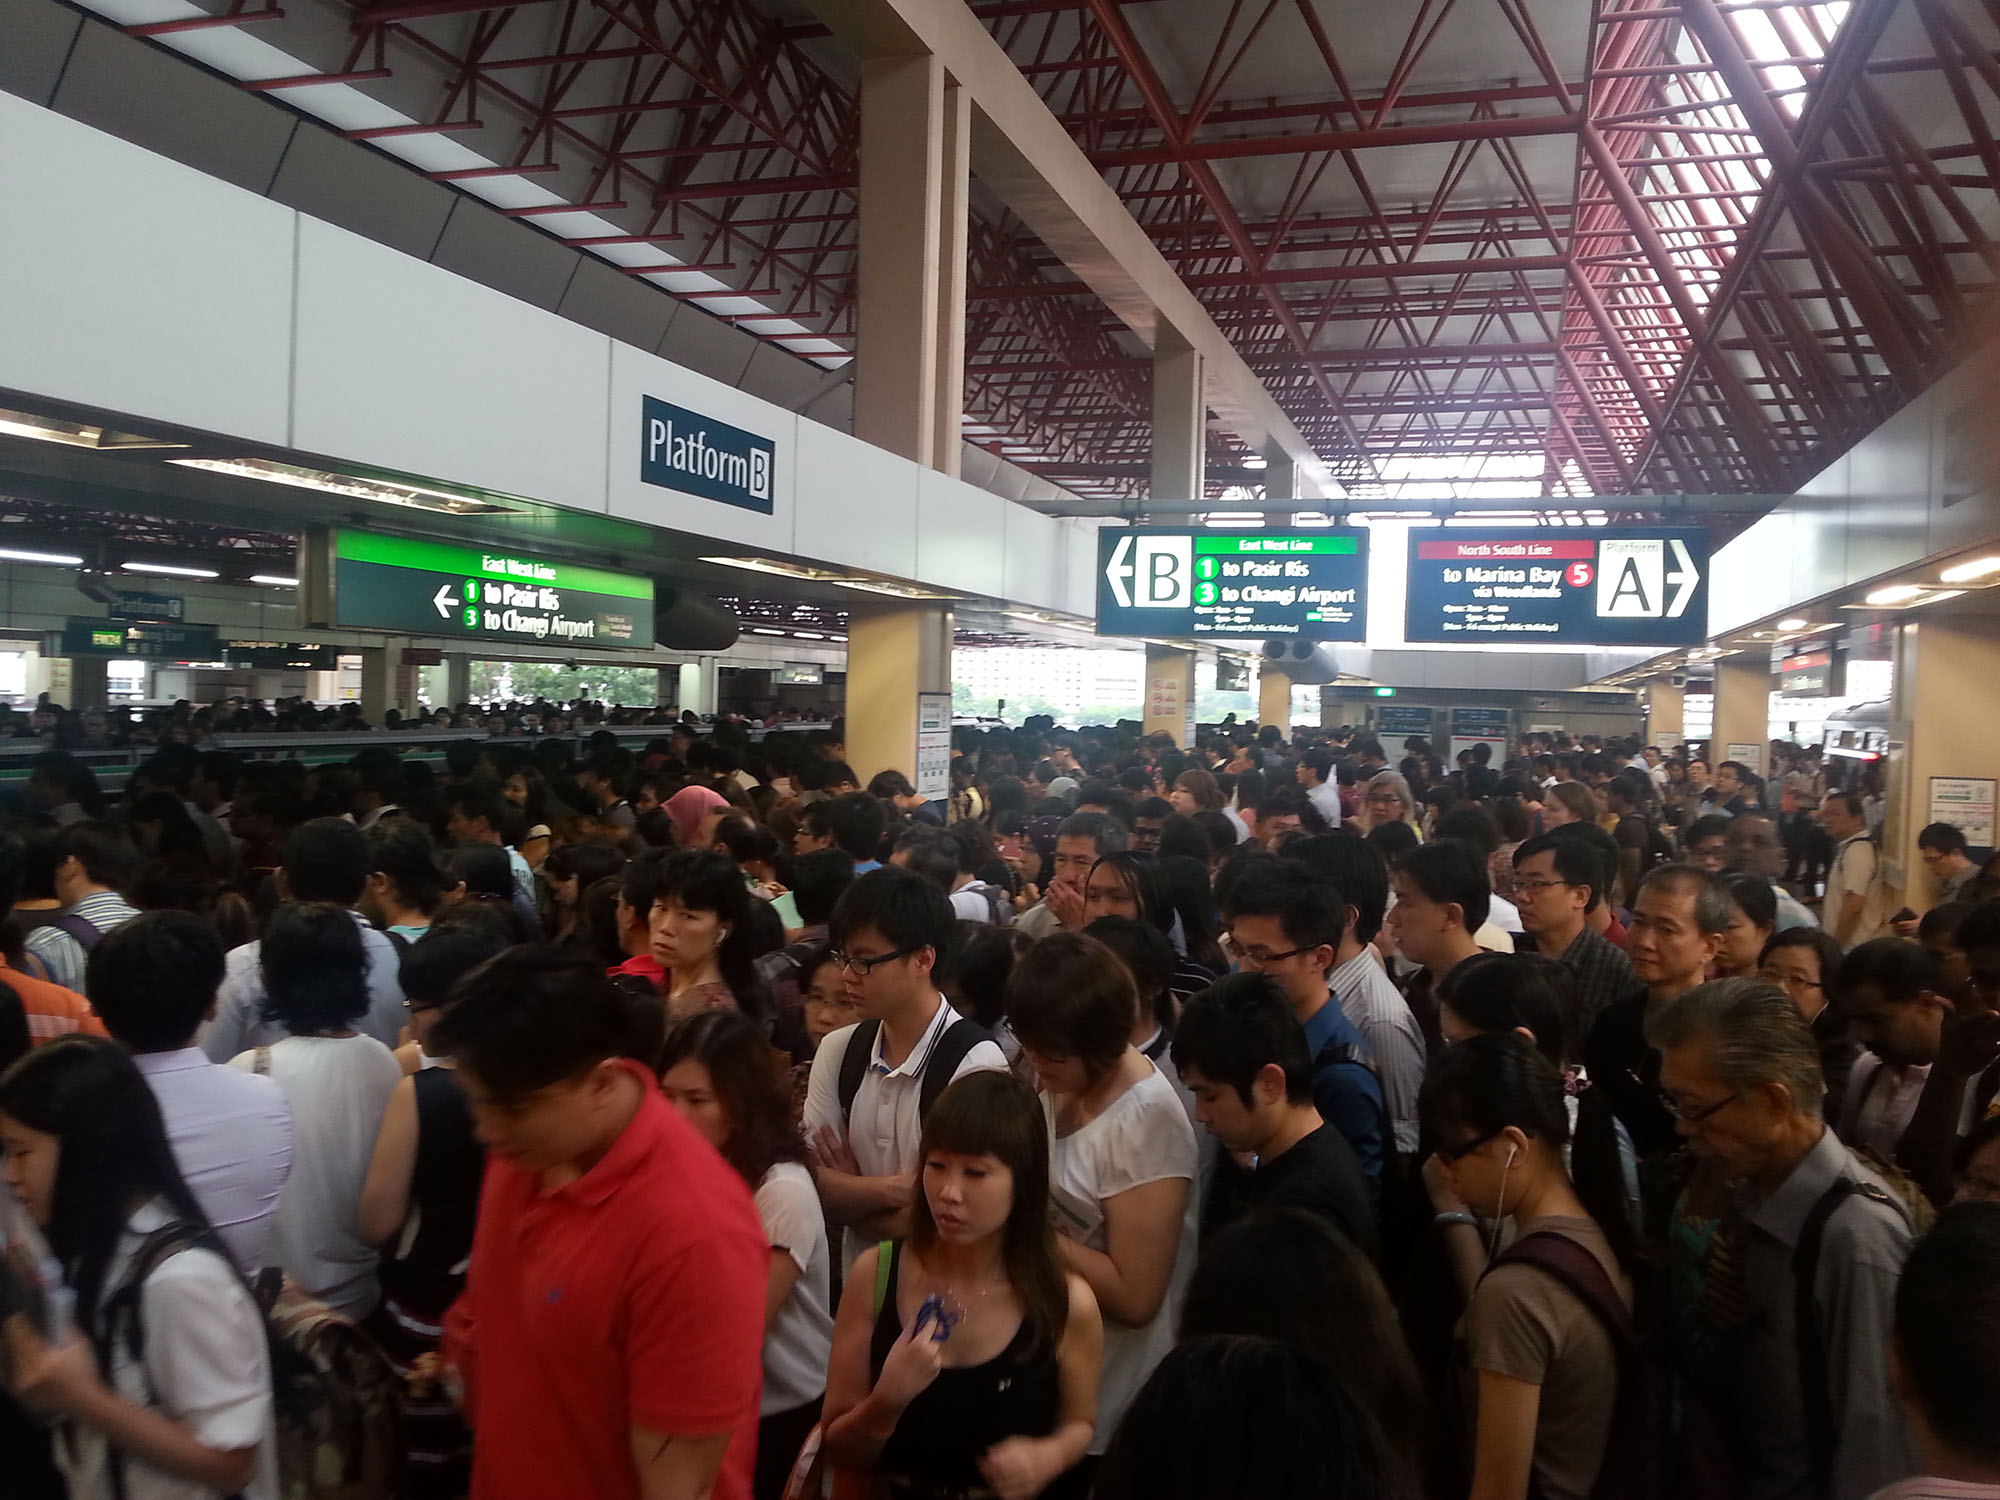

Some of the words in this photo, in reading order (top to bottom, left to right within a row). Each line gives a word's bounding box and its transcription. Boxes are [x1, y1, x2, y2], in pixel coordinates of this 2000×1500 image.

[650, 418, 748, 489] Platform
[754, 453, 766, 491] B
[1239, 539, 1261, 552] East
[1262, 539, 1289, 552] West
[1290, 539, 1313, 552] Line
[1457, 544, 1490, 555] North
[1493, 544, 1525, 555] South
[1528, 544, 1553, 555] Line
[1607, 542, 1658, 553] Platform
[482, 555, 507, 574] East
[507, 559, 534, 577] West
[534, 562, 557, 580] Line
[1149, 552, 1181, 601] B
[1200, 559, 1212, 577] 1
[1222, 561, 1239, 577] to
[1243, 560, 1282, 577] Pasir
[1284, 560, 1310, 577] Ris
[1443, 567, 1461, 583] to
[1465, 566, 1525, 583] Marina
[1529, 567, 1562, 587] Bay
[1573, 565, 1589, 583] 5
[1200, 584, 1214, 602] 3
[1221, 587, 1239, 602] to
[1241, 585, 1294, 606] Changi
[1298, 585, 1355, 606] Airport
[1472, 585, 1493, 598] via
[1608, 557, 1652, 611] A
[466, 583, 475, 599] 1
[484, 582, 502, 604] to
[502, 584, 539, 608] Pasir
[539, 588, 560, 611] Ris
[466, 611, 476, 626] 3
[484, 609, 501, 630] to
[502, 609, 550, 639] Changi
[550, 614, 595, 641] Airport
